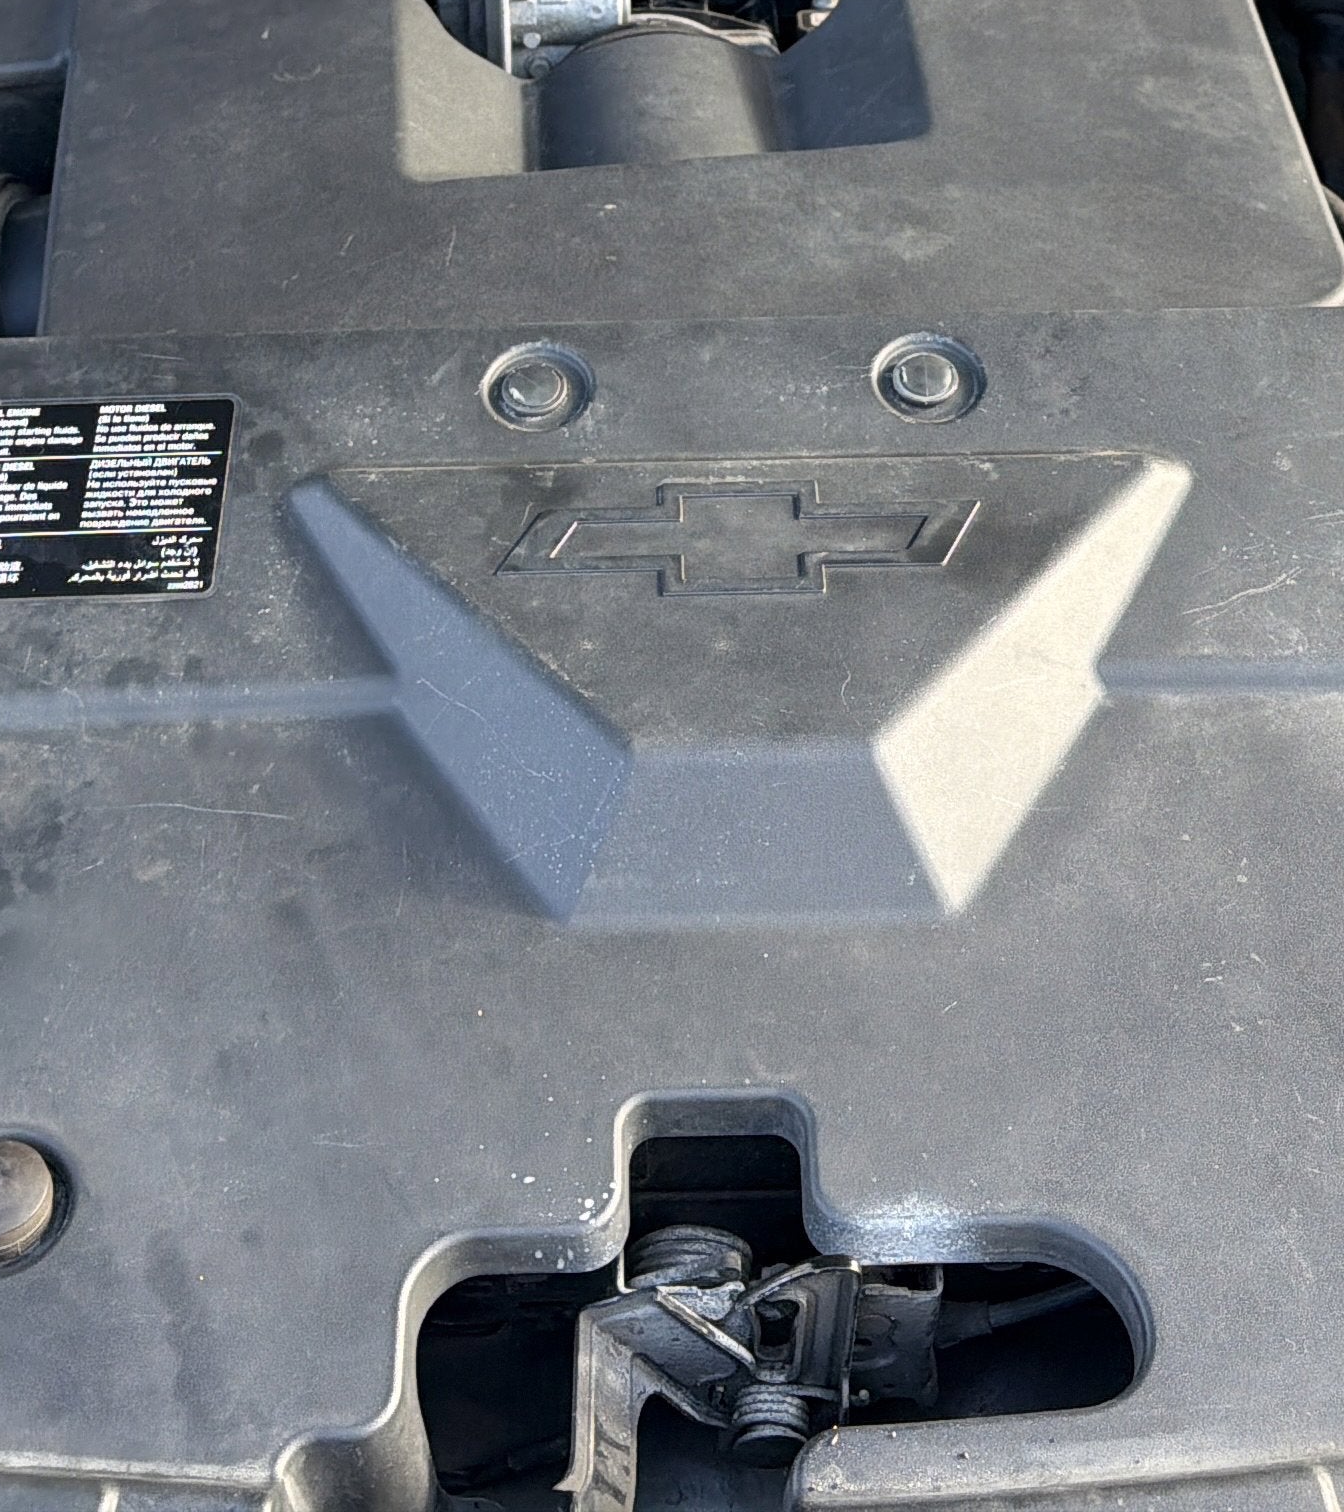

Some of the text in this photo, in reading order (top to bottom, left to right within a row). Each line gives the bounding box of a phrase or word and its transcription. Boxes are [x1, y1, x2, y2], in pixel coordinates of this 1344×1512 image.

[16, 426, 53, 437] starting
[52, 425, 81, 435] fluids.
[13, 436, 46, 447] engine
[45, 435, 84, 446] damage
